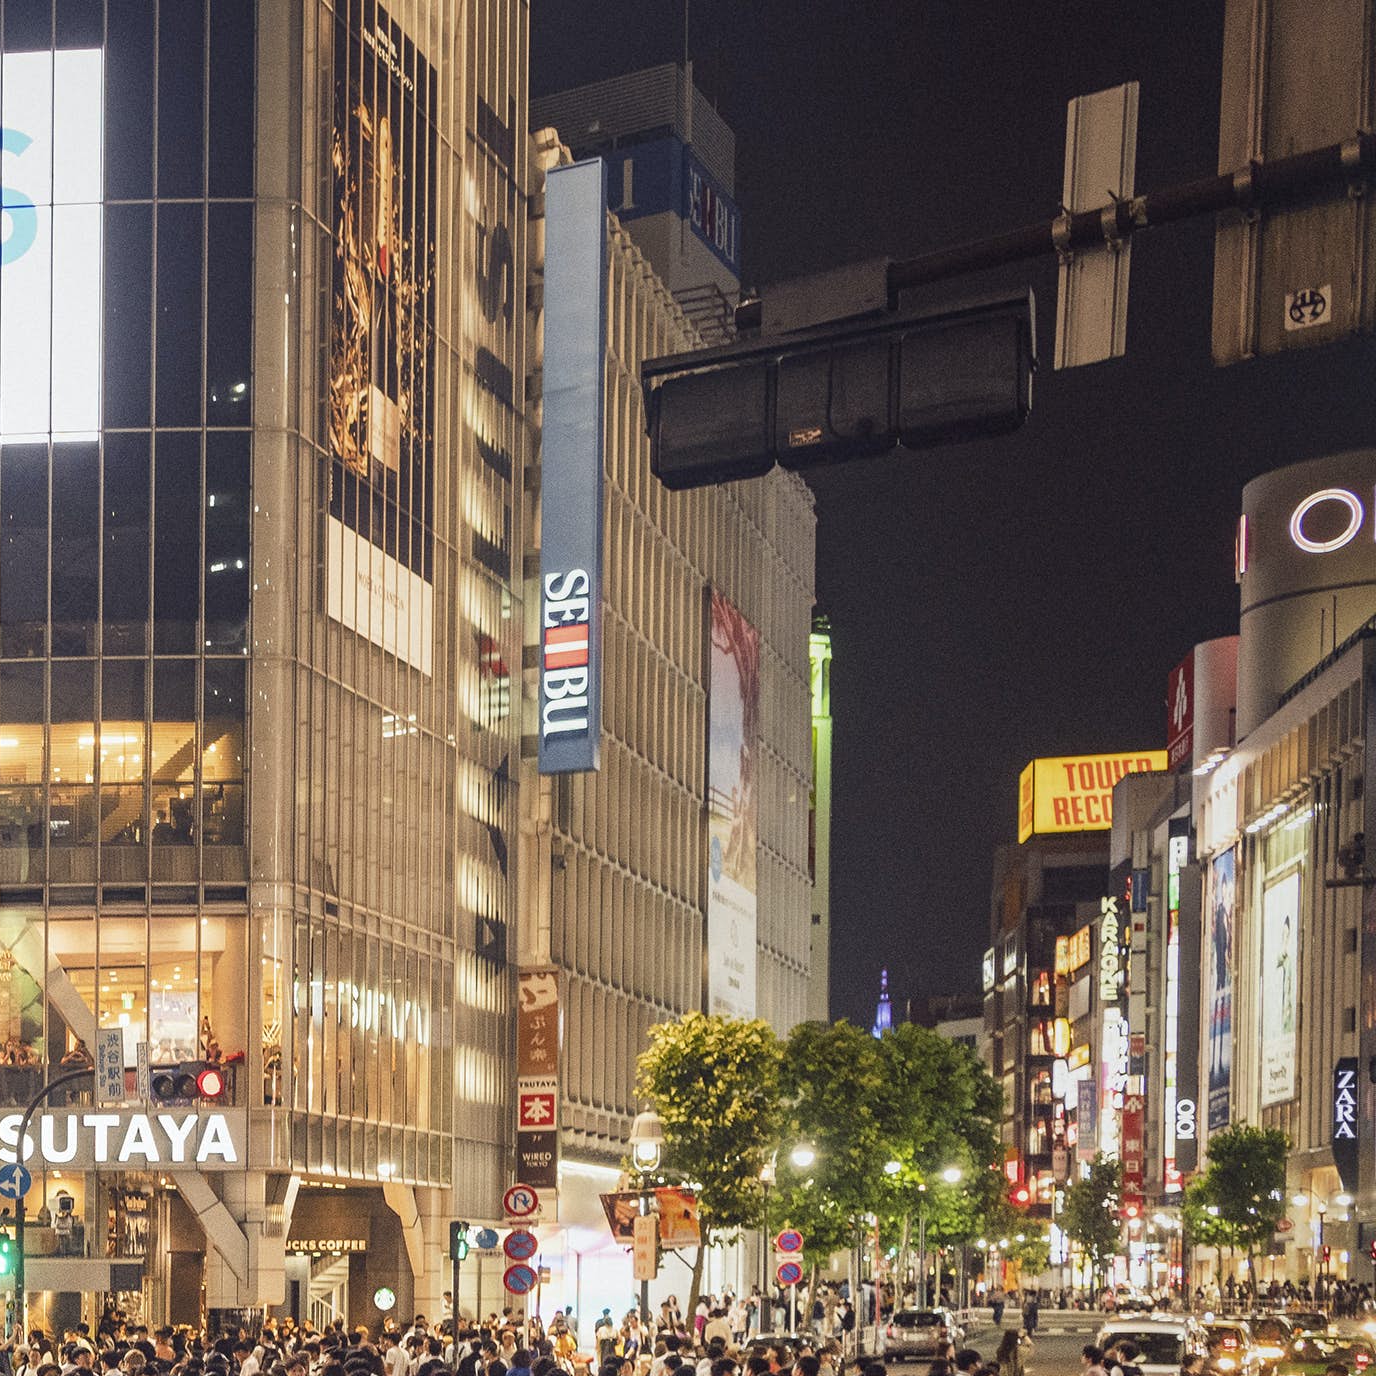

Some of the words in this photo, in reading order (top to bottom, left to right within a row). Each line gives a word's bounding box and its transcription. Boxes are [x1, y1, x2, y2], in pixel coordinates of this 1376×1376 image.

[543, 567, 590, 744] SEIBU
[1100, 896, 1119, 1001] KARAOKE
[107, 1032, 121, 1097] 渋谷駅前
[519, 1081, 557, 1089] TSUTAYA
[524, 1096, 551, 1124] 本
[1334, 1070, 1356, 1139] ZARA
[318, 1239, 367, 1251] COFFEE
